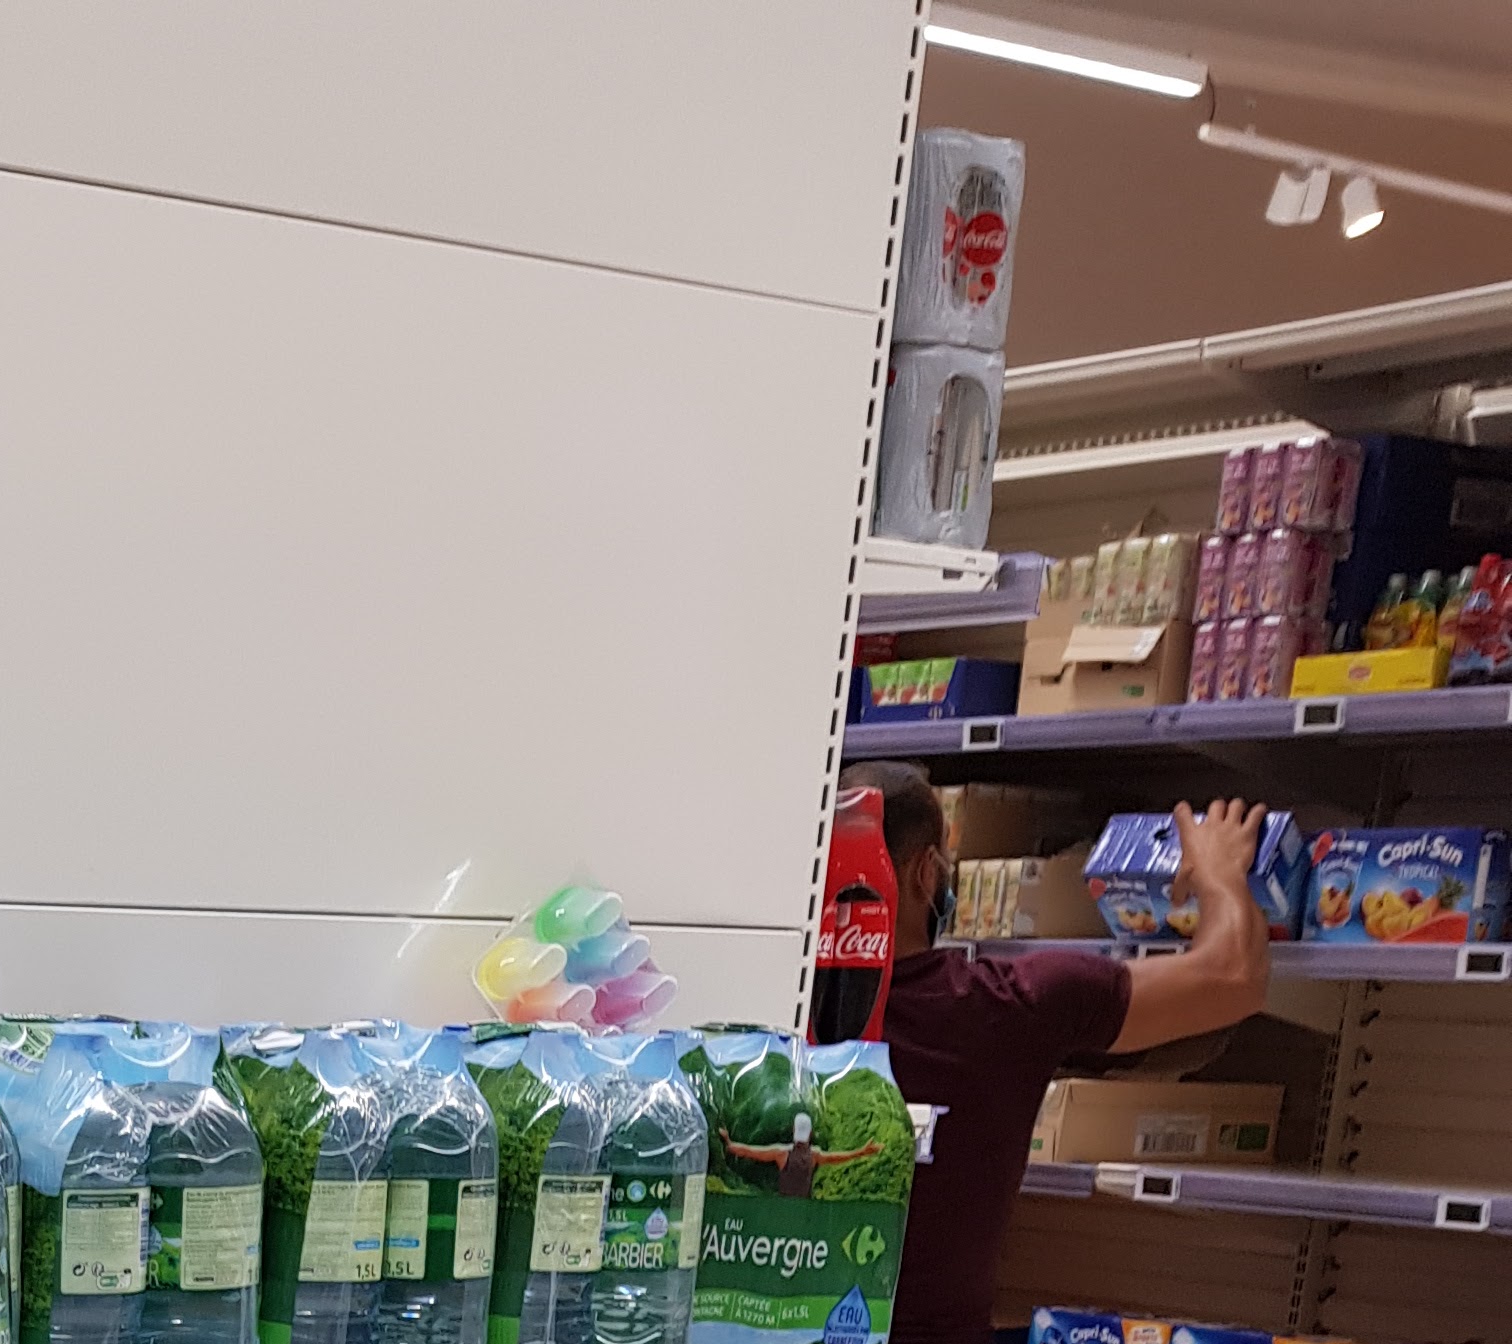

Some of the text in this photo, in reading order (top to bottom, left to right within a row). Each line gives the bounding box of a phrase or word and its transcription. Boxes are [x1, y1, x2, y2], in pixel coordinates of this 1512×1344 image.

[1378, 833, 1464, 868] Capri-Sun
[724, 1217, 744, 1231] EAU
[702, 1223, 829, 1278] 'Auvergne
[838, 1305, 864, 1326] EAU
